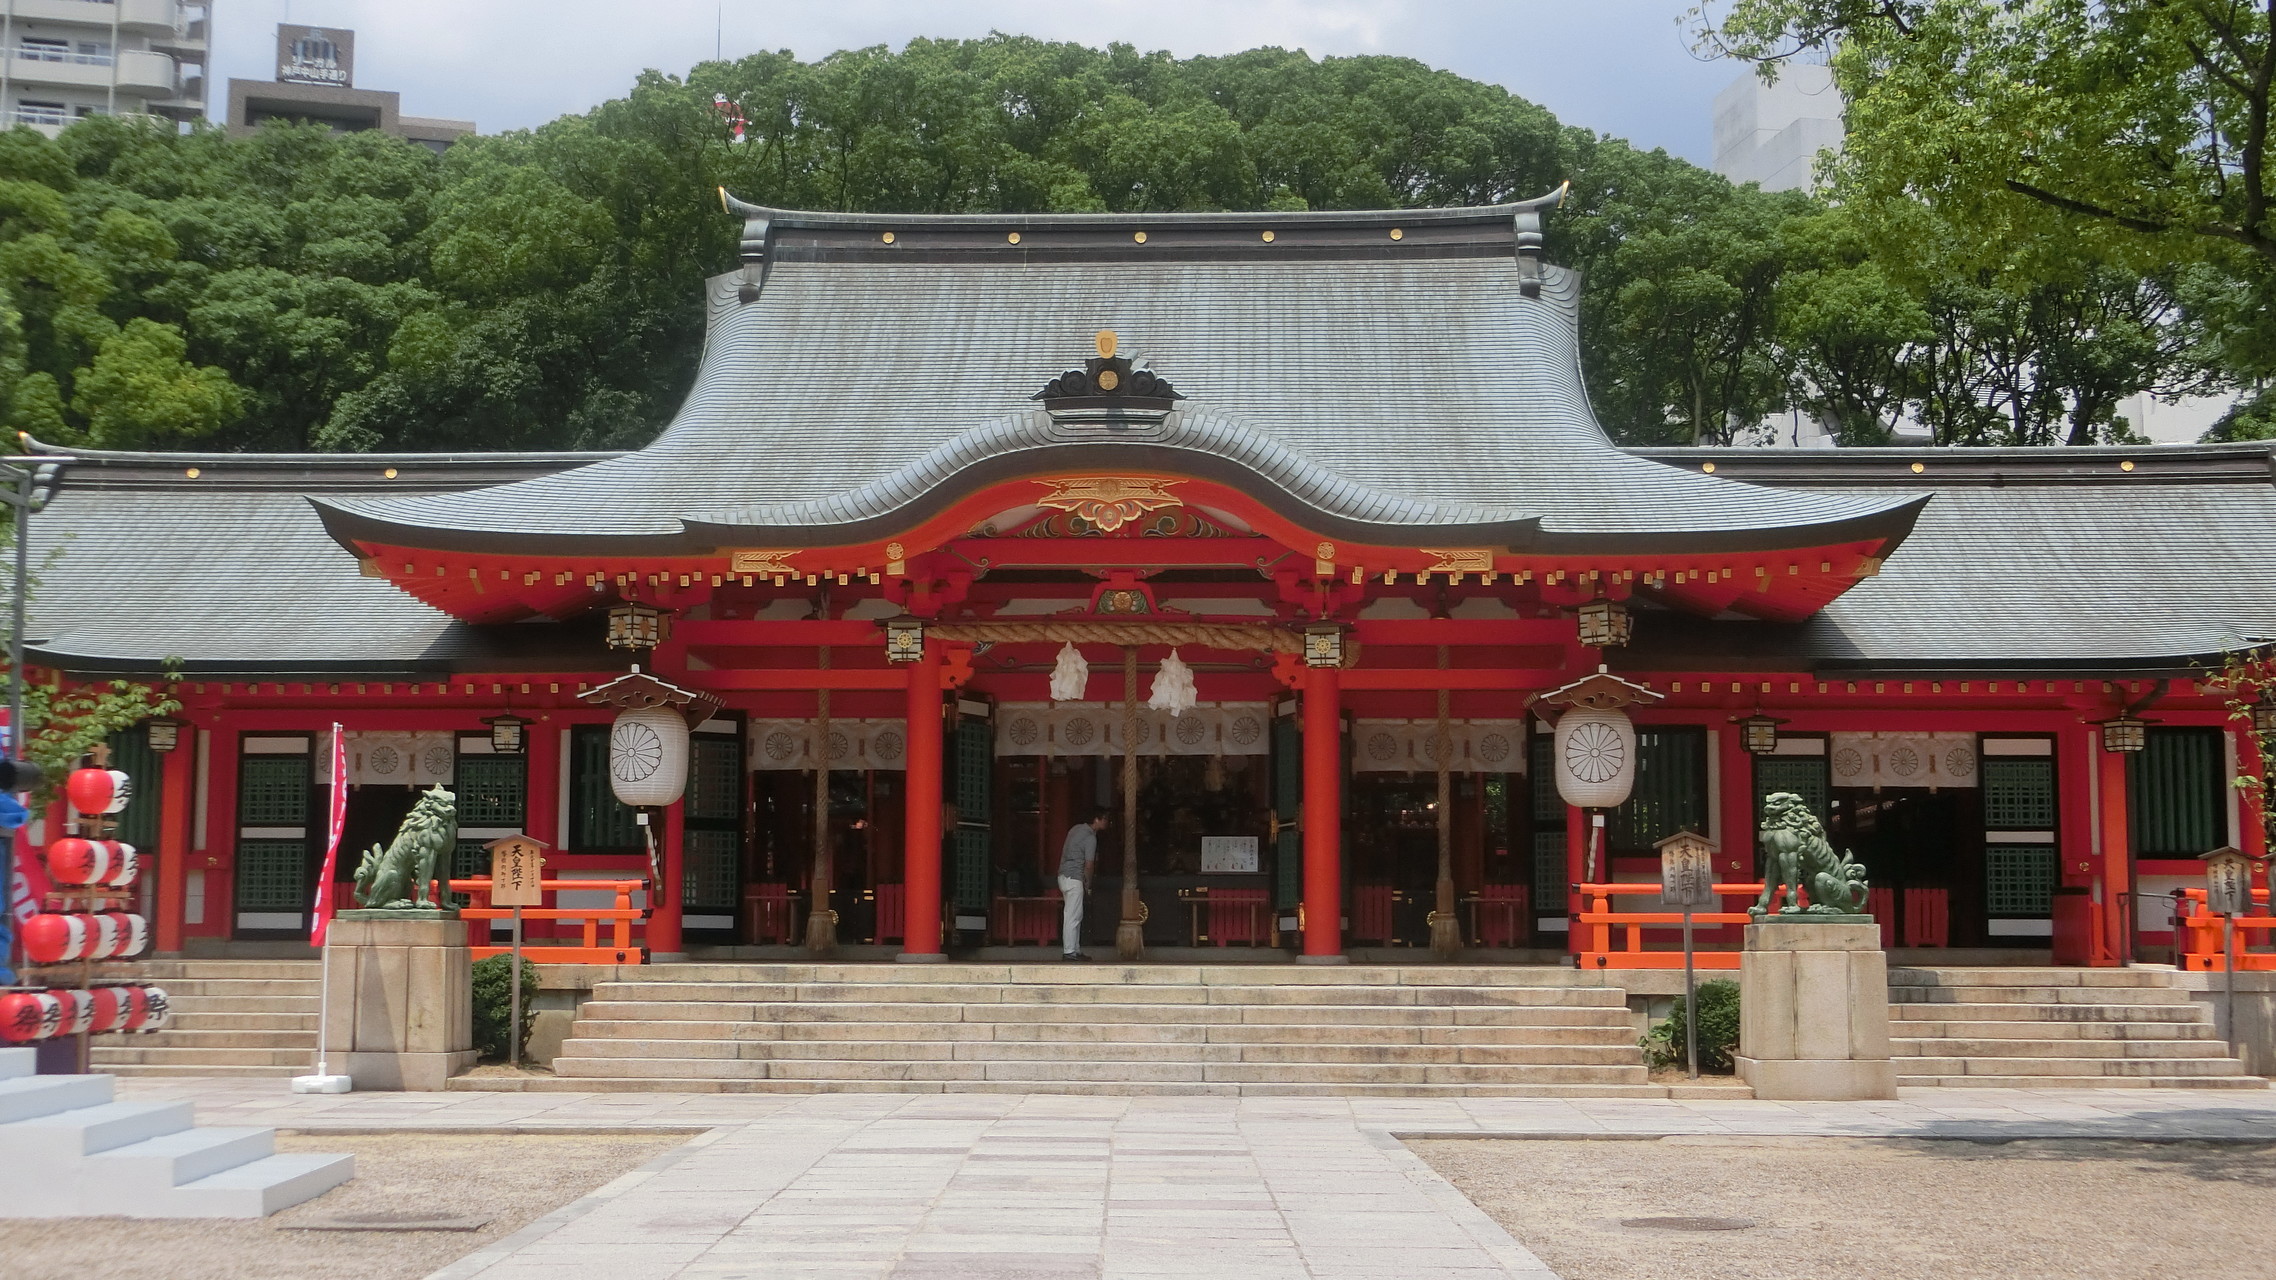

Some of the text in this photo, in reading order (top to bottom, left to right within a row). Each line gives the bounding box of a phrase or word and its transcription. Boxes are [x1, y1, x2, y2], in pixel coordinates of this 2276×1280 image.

[281, 65, 347, 82] 神戸中山手通り
[511, 844, 524, 891] 天皇陛下
[1680, 844, 1694, 898] 天皇陛下
[2224, 858, 2236, 901] 天皇陛下
[148, 993, 169, 1021] 祭
